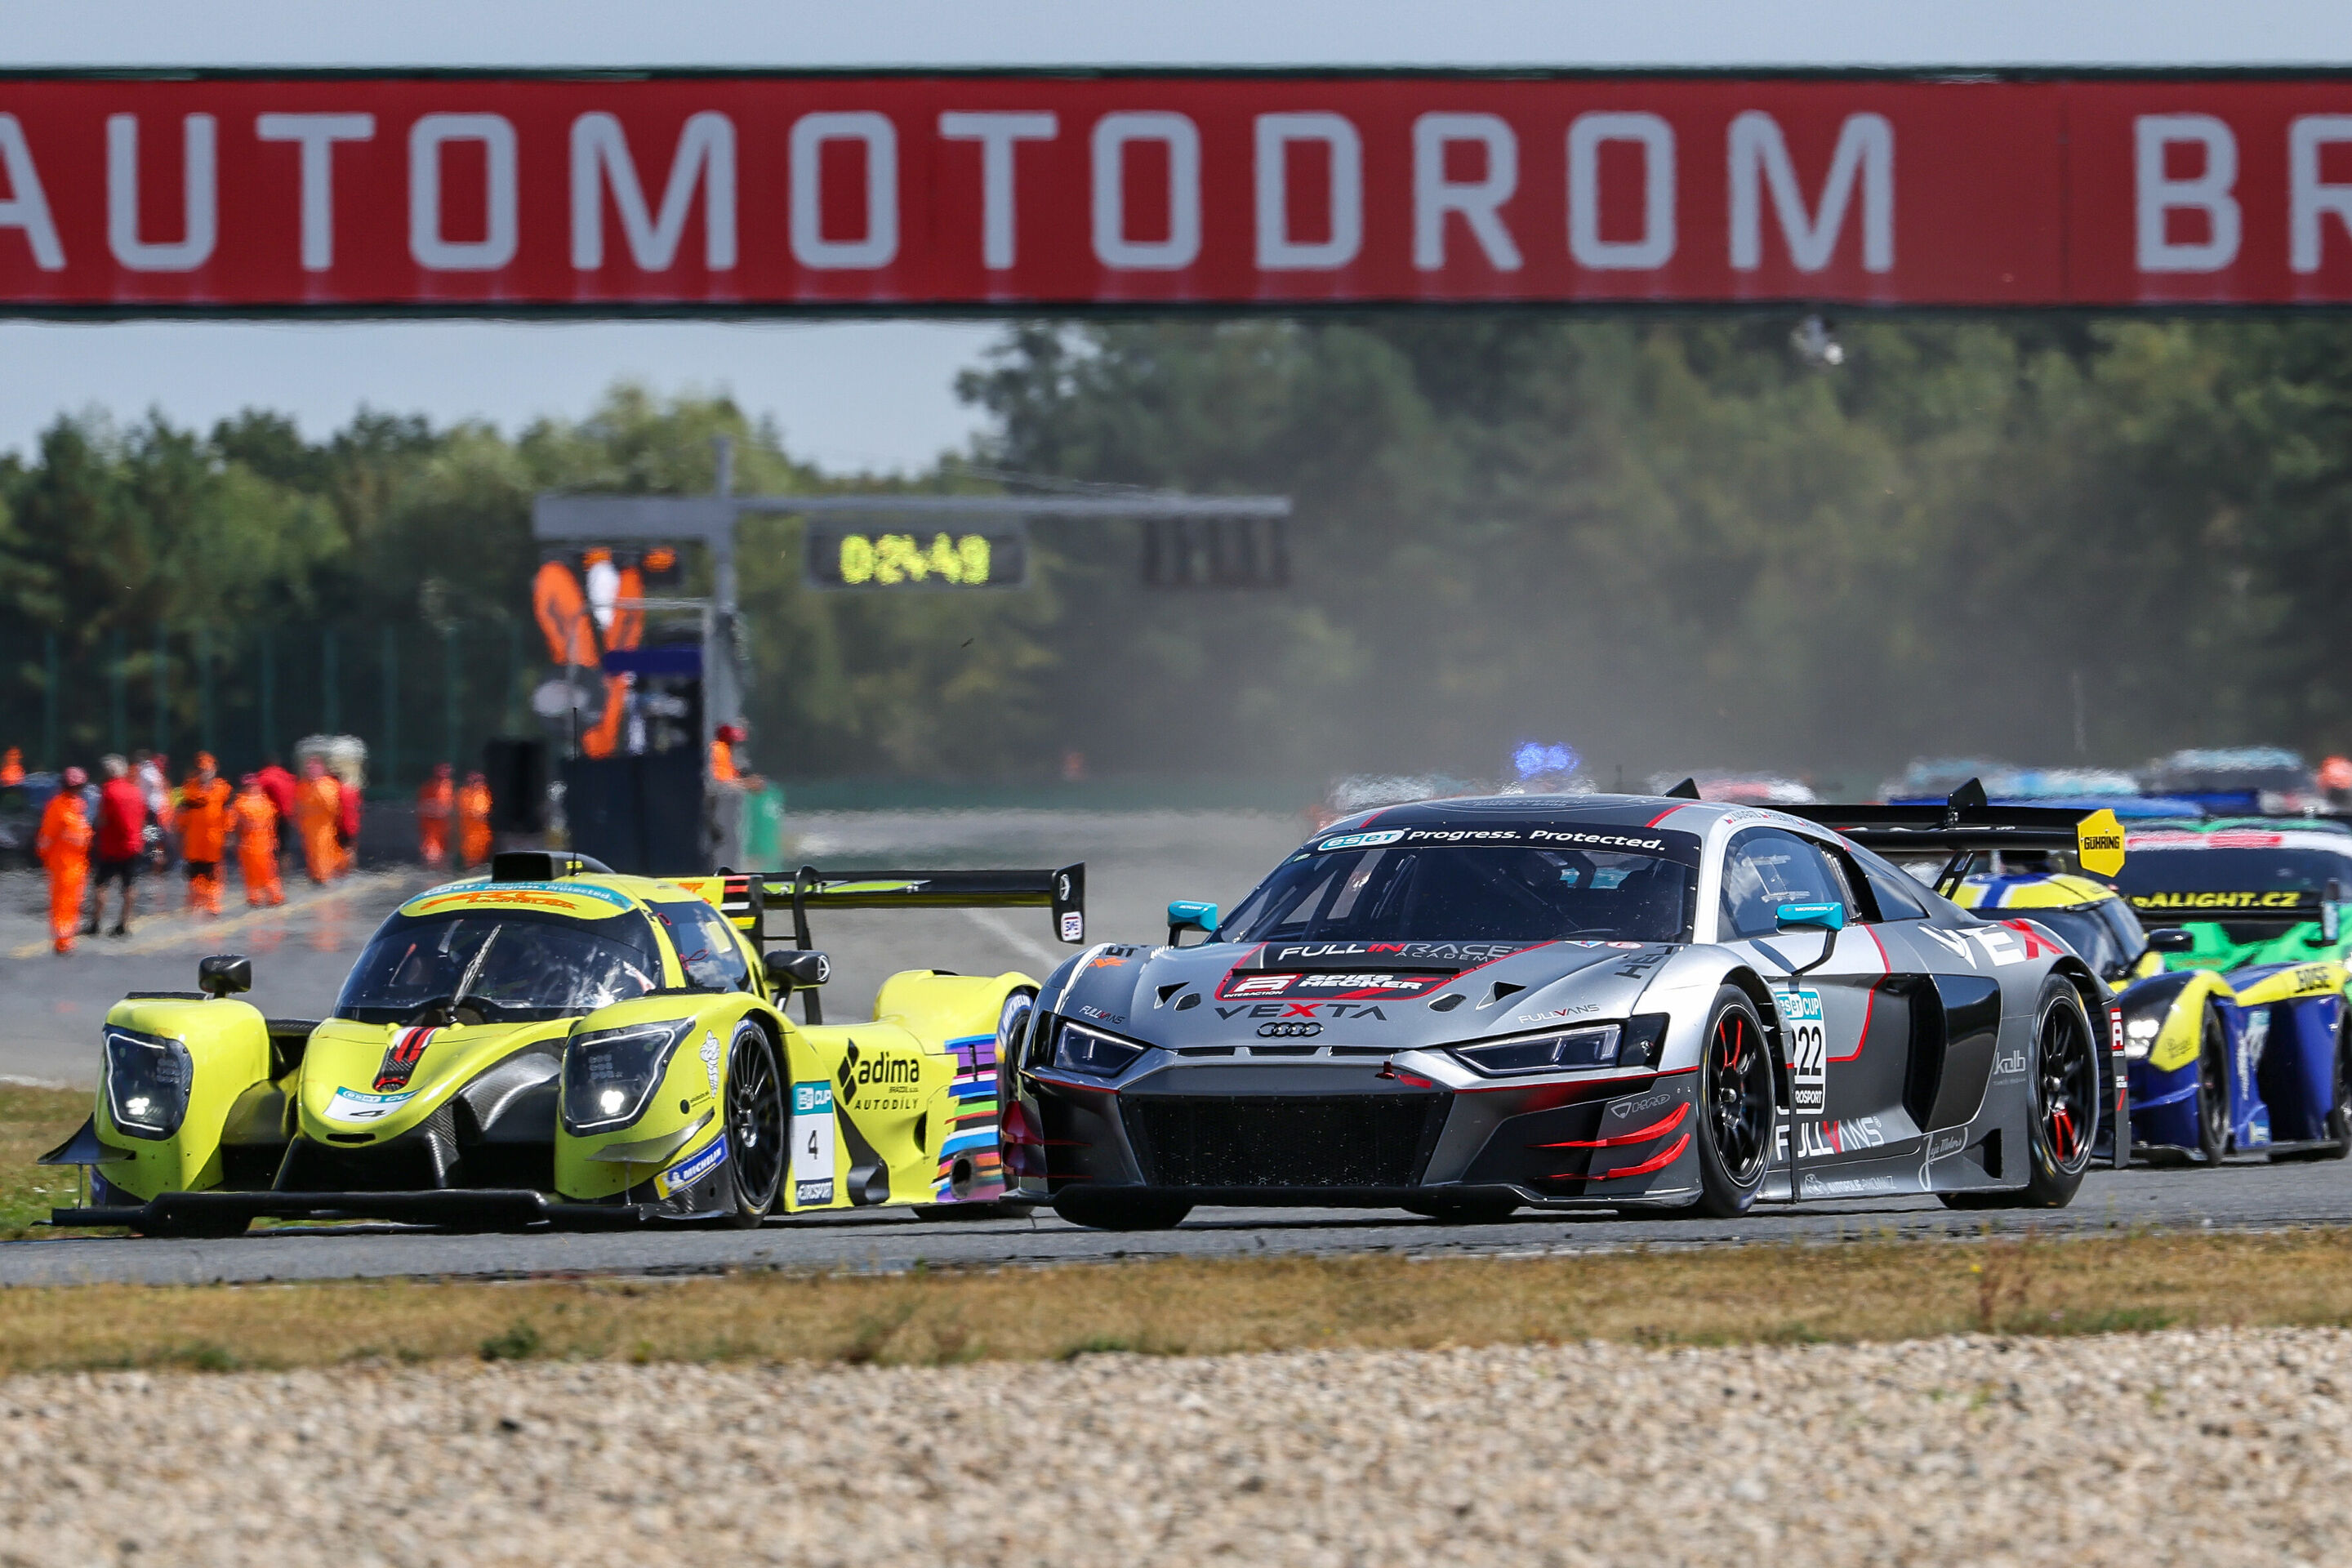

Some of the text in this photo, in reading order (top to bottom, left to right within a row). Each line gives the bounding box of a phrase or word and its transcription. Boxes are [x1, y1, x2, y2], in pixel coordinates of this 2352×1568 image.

[0, 110, 1894, 271] AUTOMOTODROM
[1407, 829, 1522, 842] Progress.
[1529, 829, 1666, 851] Protected.
[2084, 835, 2120, 850] GÜHRING
[1393, 951, 1500, 963] ACADEM
[1298, 980, 1423, 991] HECKER
[1303, 973, 1393, 982] SPIES
[1223, 991, 1285, 999] INTERACTION
[1079, 1004, 1126, 1025] FULLVANS
[1214, 1003, 1388, 1022] VEXTA
[1518, 1004, 1601, 1024] FULLVANS
[1802, 997, 1820, 1016] CUP
[1793, 1026, 1822, 1076] 22
[858, 1051, 920, 1085] adima
[854, 1097, 919, 1110] AUTODÍLY
[1795, 1090, 1823, 1104] ROSPORT
[349, 1109, 386, 1118] 4
[808, 1129, 819, 1160] 4
[683, 1147, 722, 1179] MICHELIN
